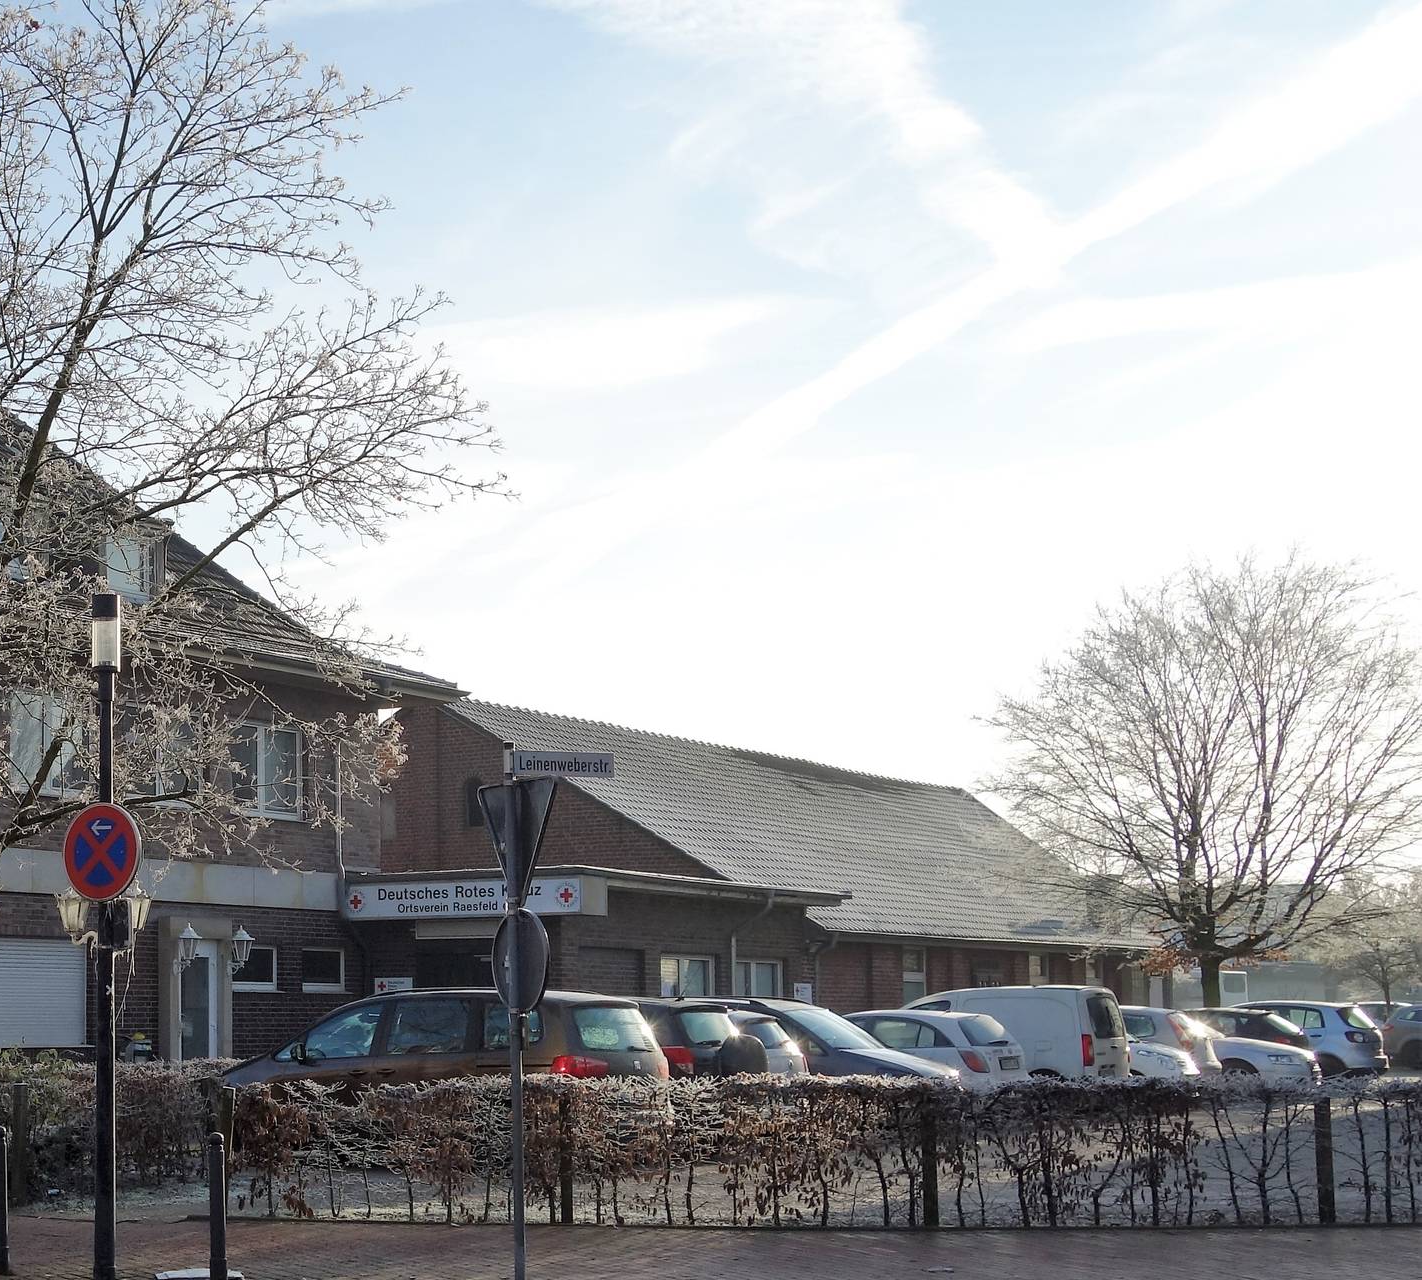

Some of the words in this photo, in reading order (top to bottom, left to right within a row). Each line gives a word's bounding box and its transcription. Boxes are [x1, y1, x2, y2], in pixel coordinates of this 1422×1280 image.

[519, 755, 612, 774] Leinenweberstr.
[378, 885, 449, 901] Deutsches
[455, 884, 495, 898] Rotes
[501, 884, 542, 897] Kuz
[397, 902, 449, 913] Ortsverein
[453, 900, 498, 912] Raesfeld
